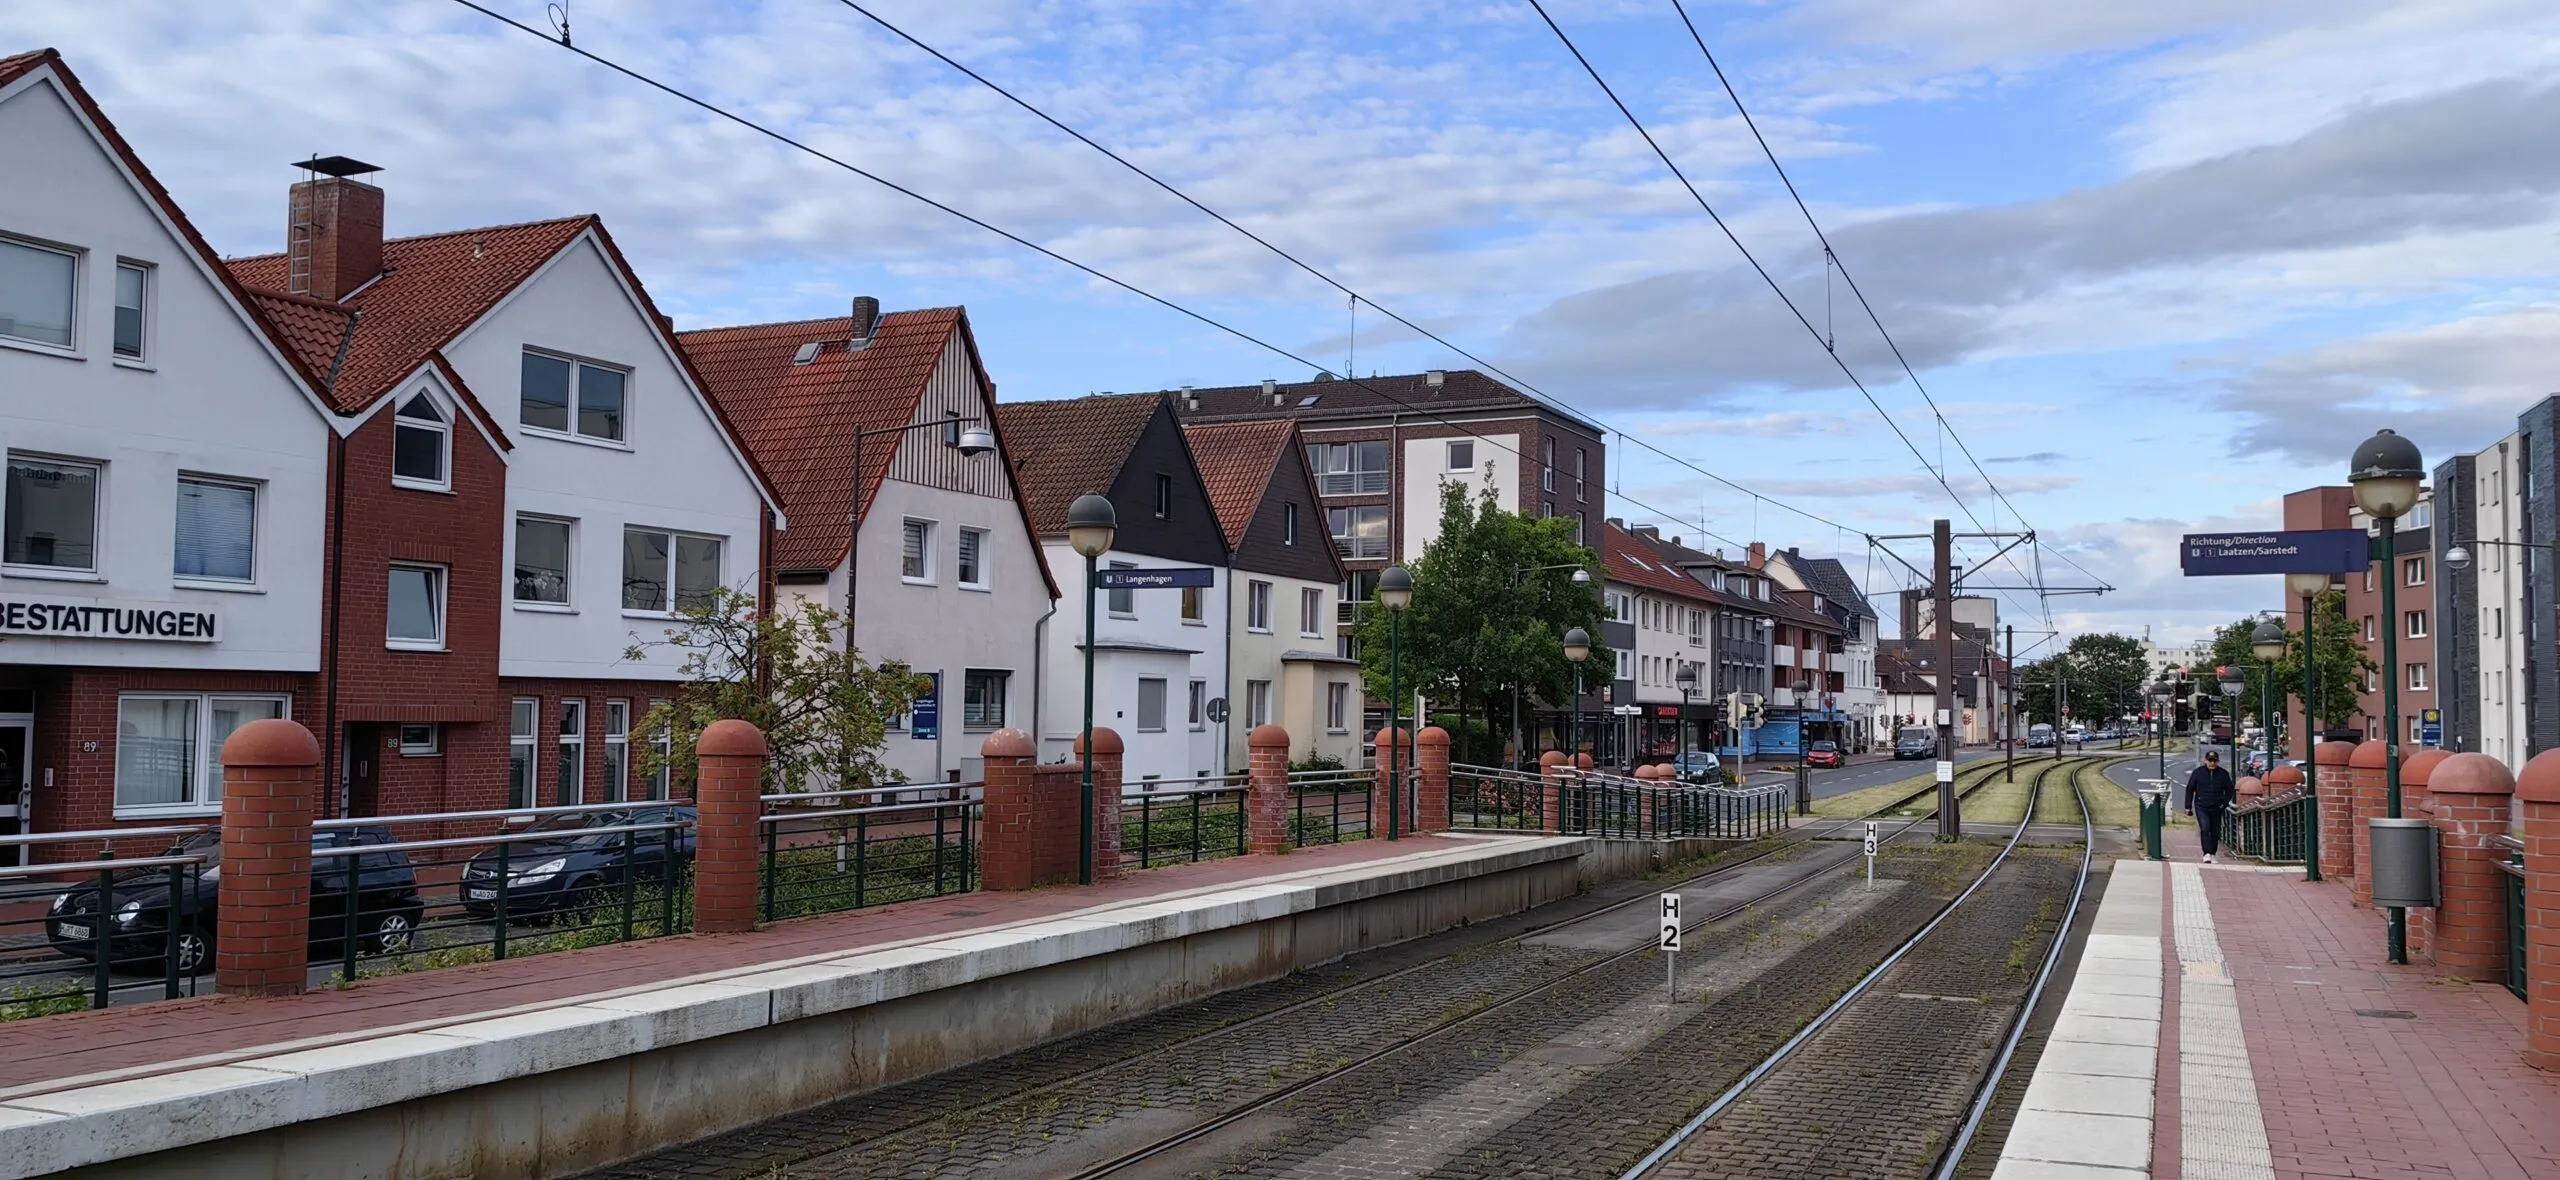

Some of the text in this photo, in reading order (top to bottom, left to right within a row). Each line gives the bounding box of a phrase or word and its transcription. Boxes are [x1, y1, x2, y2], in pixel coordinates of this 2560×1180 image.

[2190, 536, 2277, 547] Richtung/Direction
[2192, 548, 2200, 557] U
[2218, 546, 2298, 556] Laatzen/Sarstedt
[1106, 575, 1113, 583] U
[1126, 575, 1173, 585] Langenhagen
[0, 602, 215, 637] ESTATTUNGEN
[84, 741, 97, 752] 89
[1866, 824, 1876, 837] H
[1866, 840, 1875, 853] 3
[1663, 897, 1678, 918] H
[1663, 925, 1678, 947] 2
